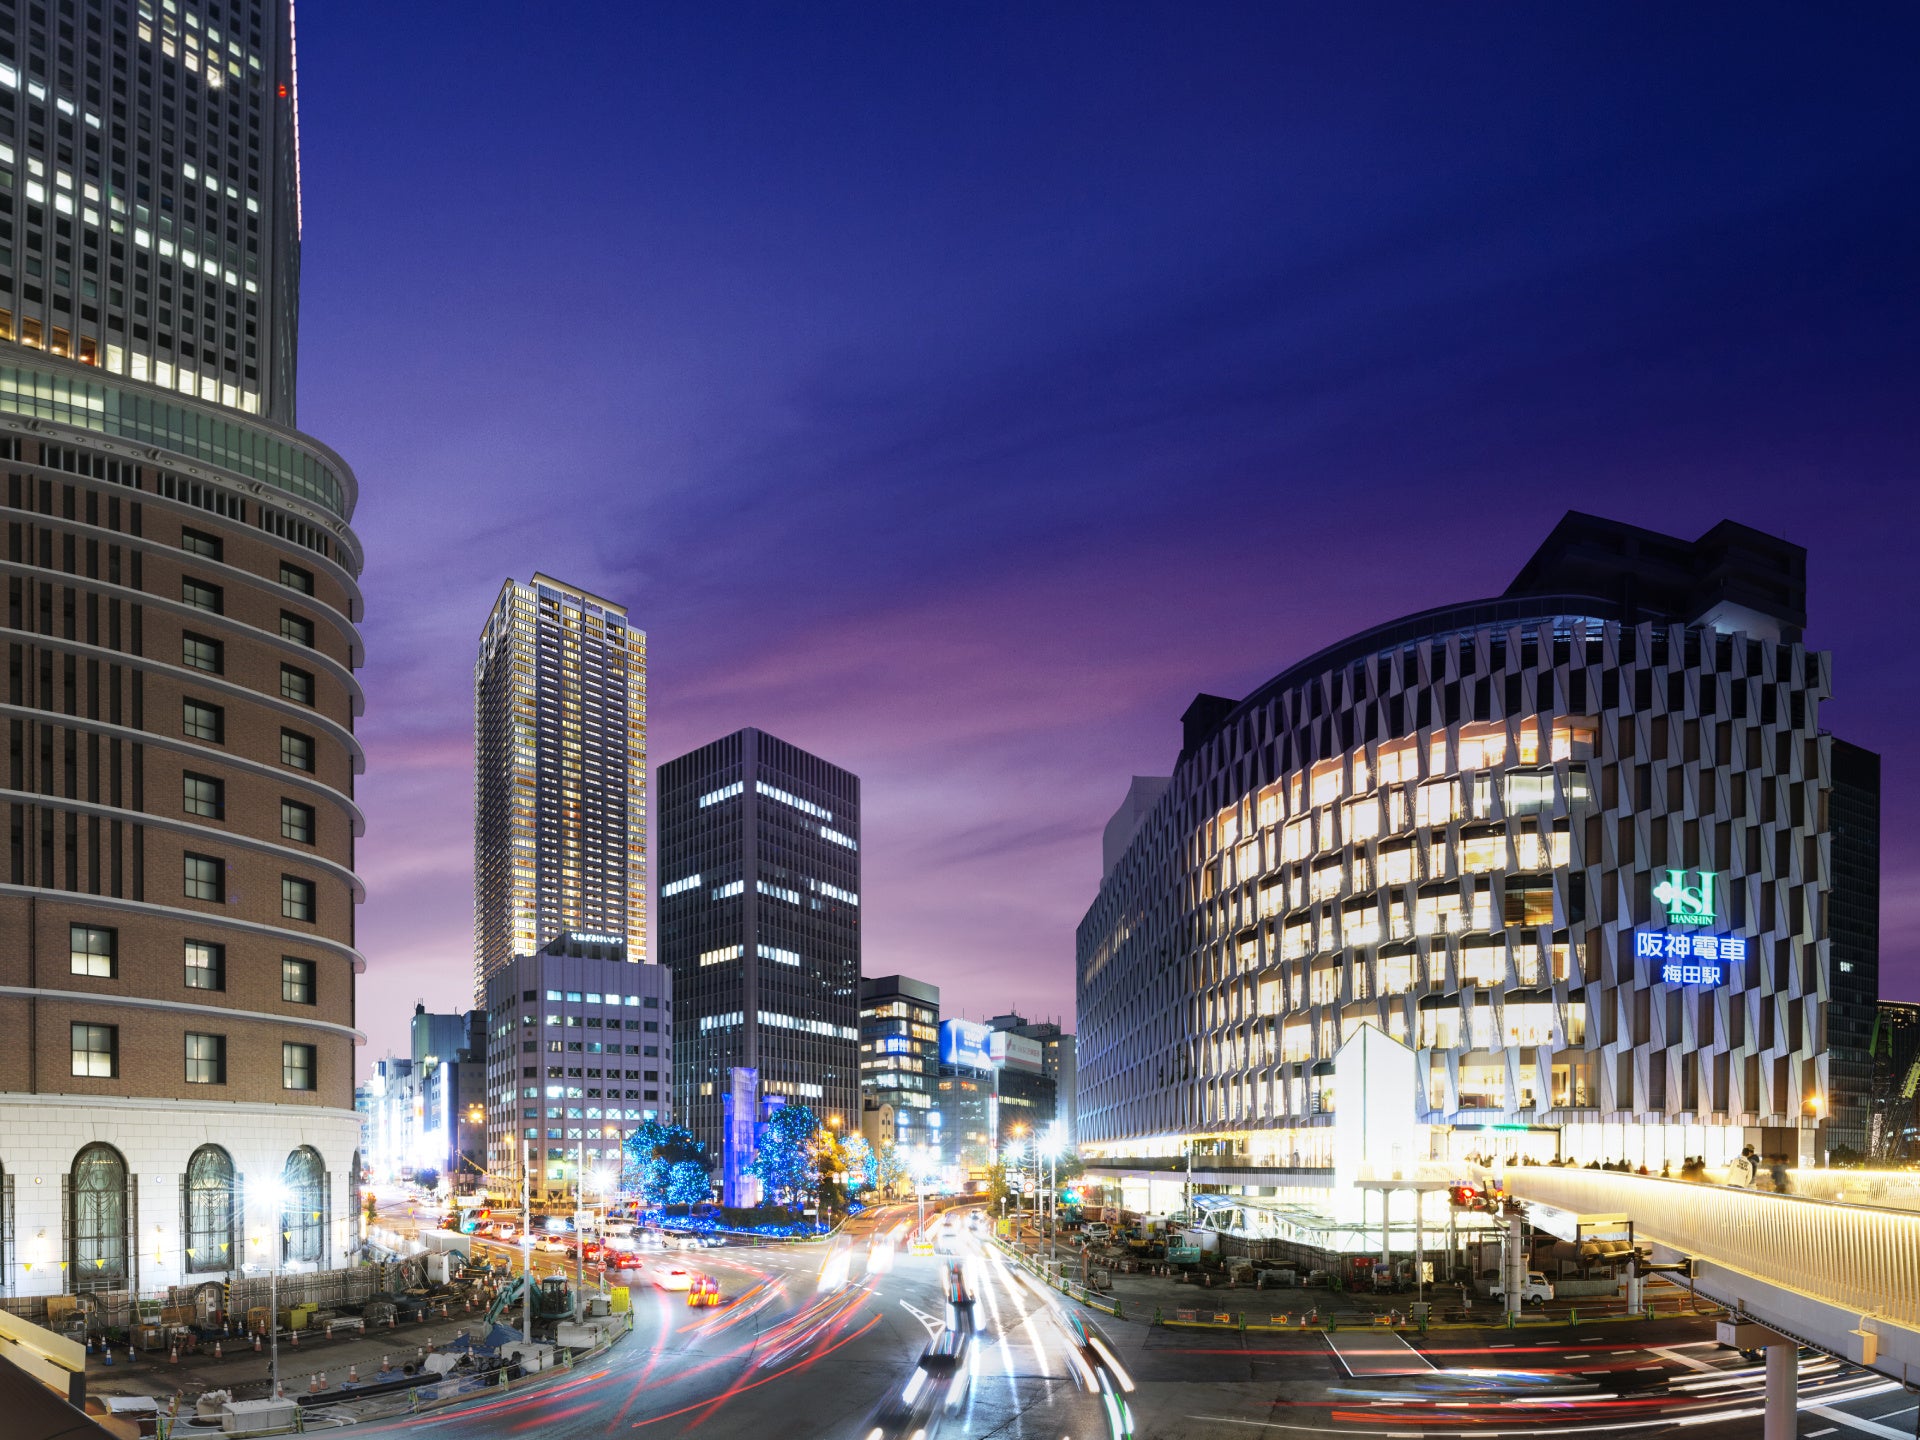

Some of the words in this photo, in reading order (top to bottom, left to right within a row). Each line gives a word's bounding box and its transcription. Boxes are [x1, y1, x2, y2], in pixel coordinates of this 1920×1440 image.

[1671, 914, 1713, 925] HANSHIN
[1637, 932, 1746, 961] 阪神電車
[1662, 964, 1721, 984] 梅田駅
